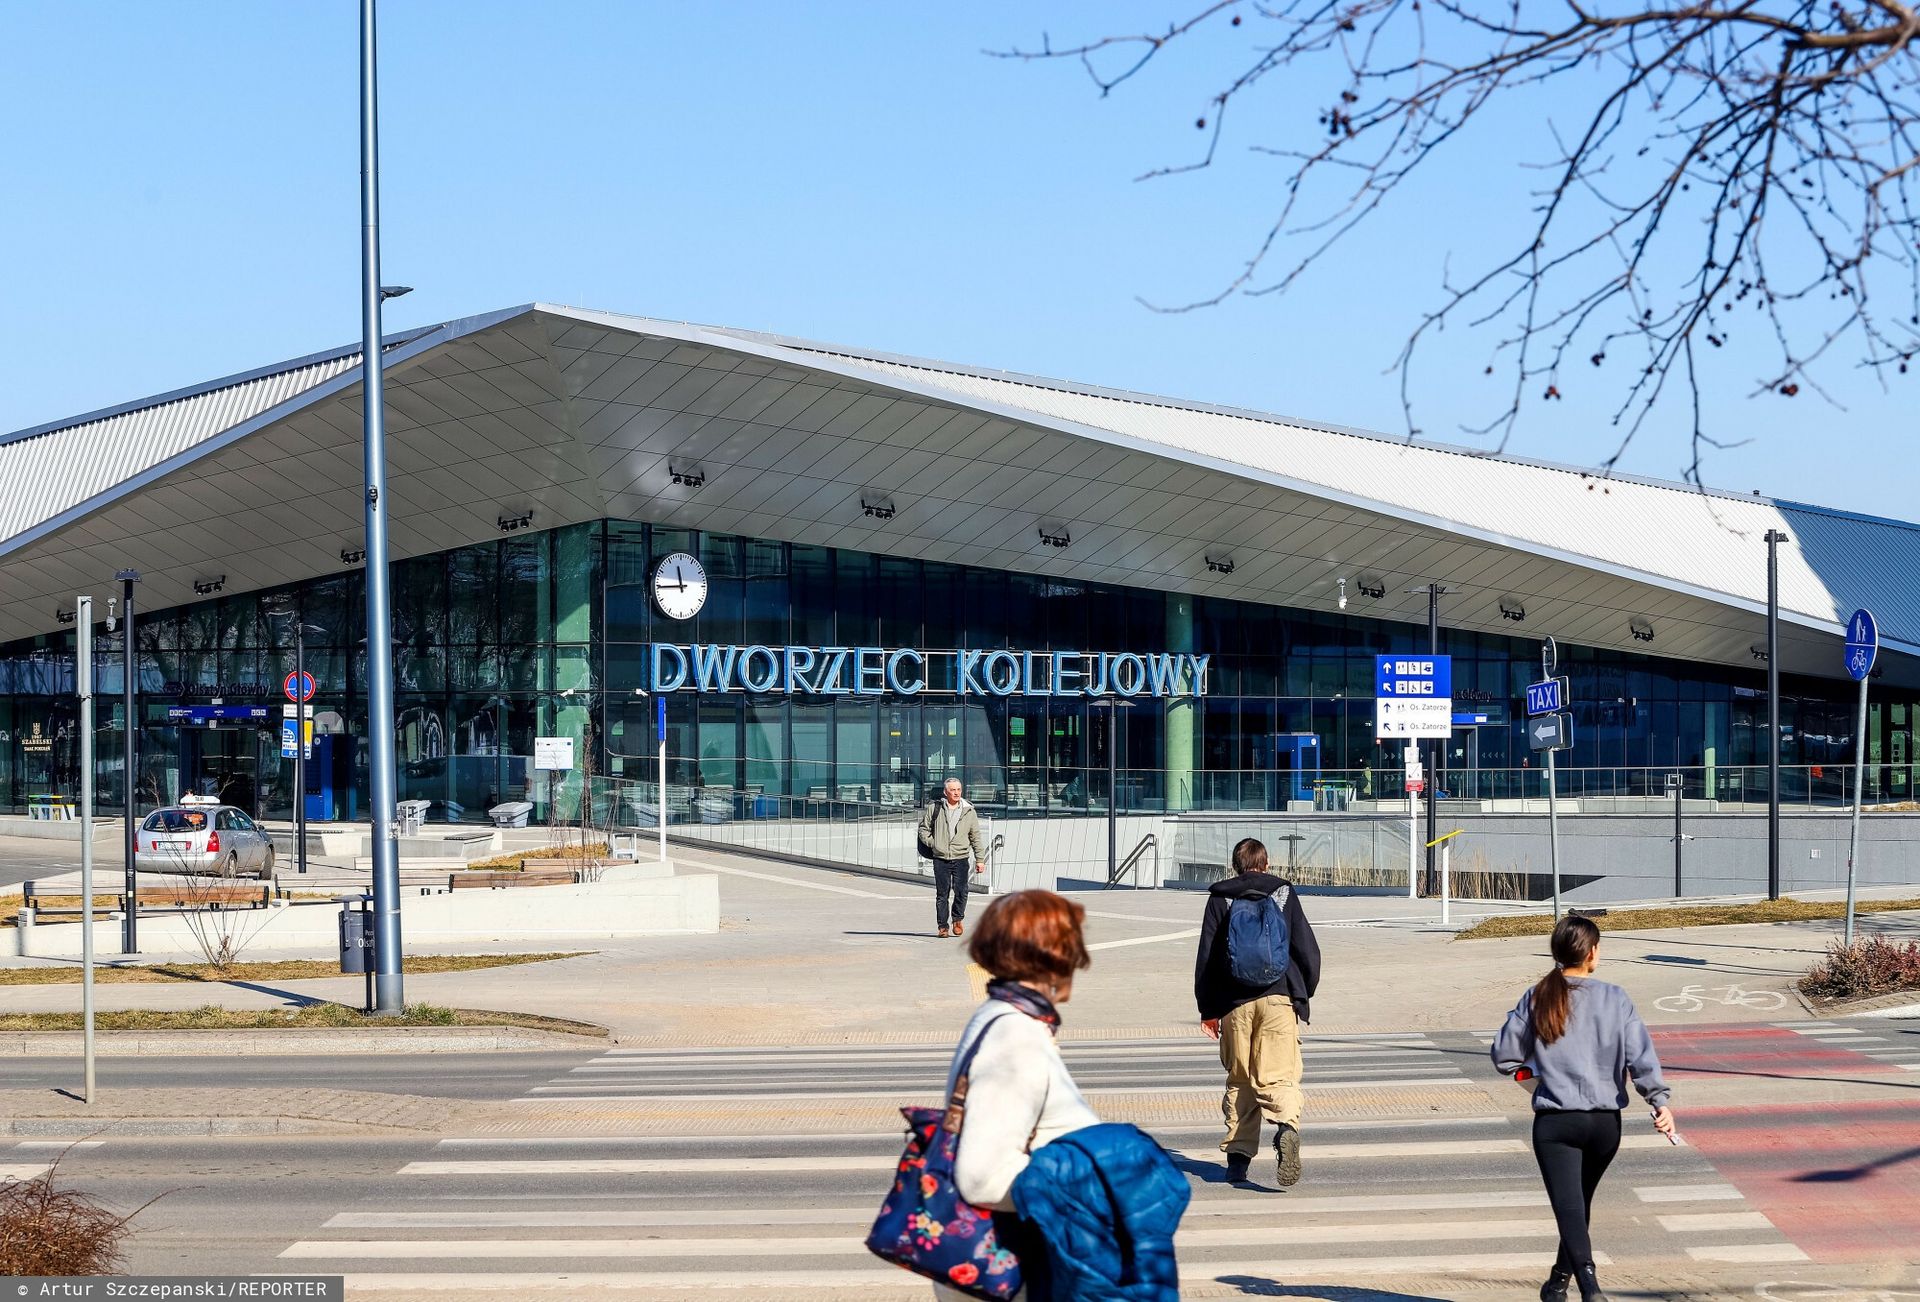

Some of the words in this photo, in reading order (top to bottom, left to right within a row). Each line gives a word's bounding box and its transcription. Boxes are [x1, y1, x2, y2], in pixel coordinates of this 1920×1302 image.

[650, 643, 924, 695] DWORZEC
[957, 648, 1211, 698] KOLEJOWY
[1410, 703, 1421, 711] Os.
[1422, 703, 1447, 711] Zatorze
[1529, 684, 1558, 713] TAXI
[1410, 722, 1421, 730] Os.
[1422, 722, 1447, 730] Zatorze
